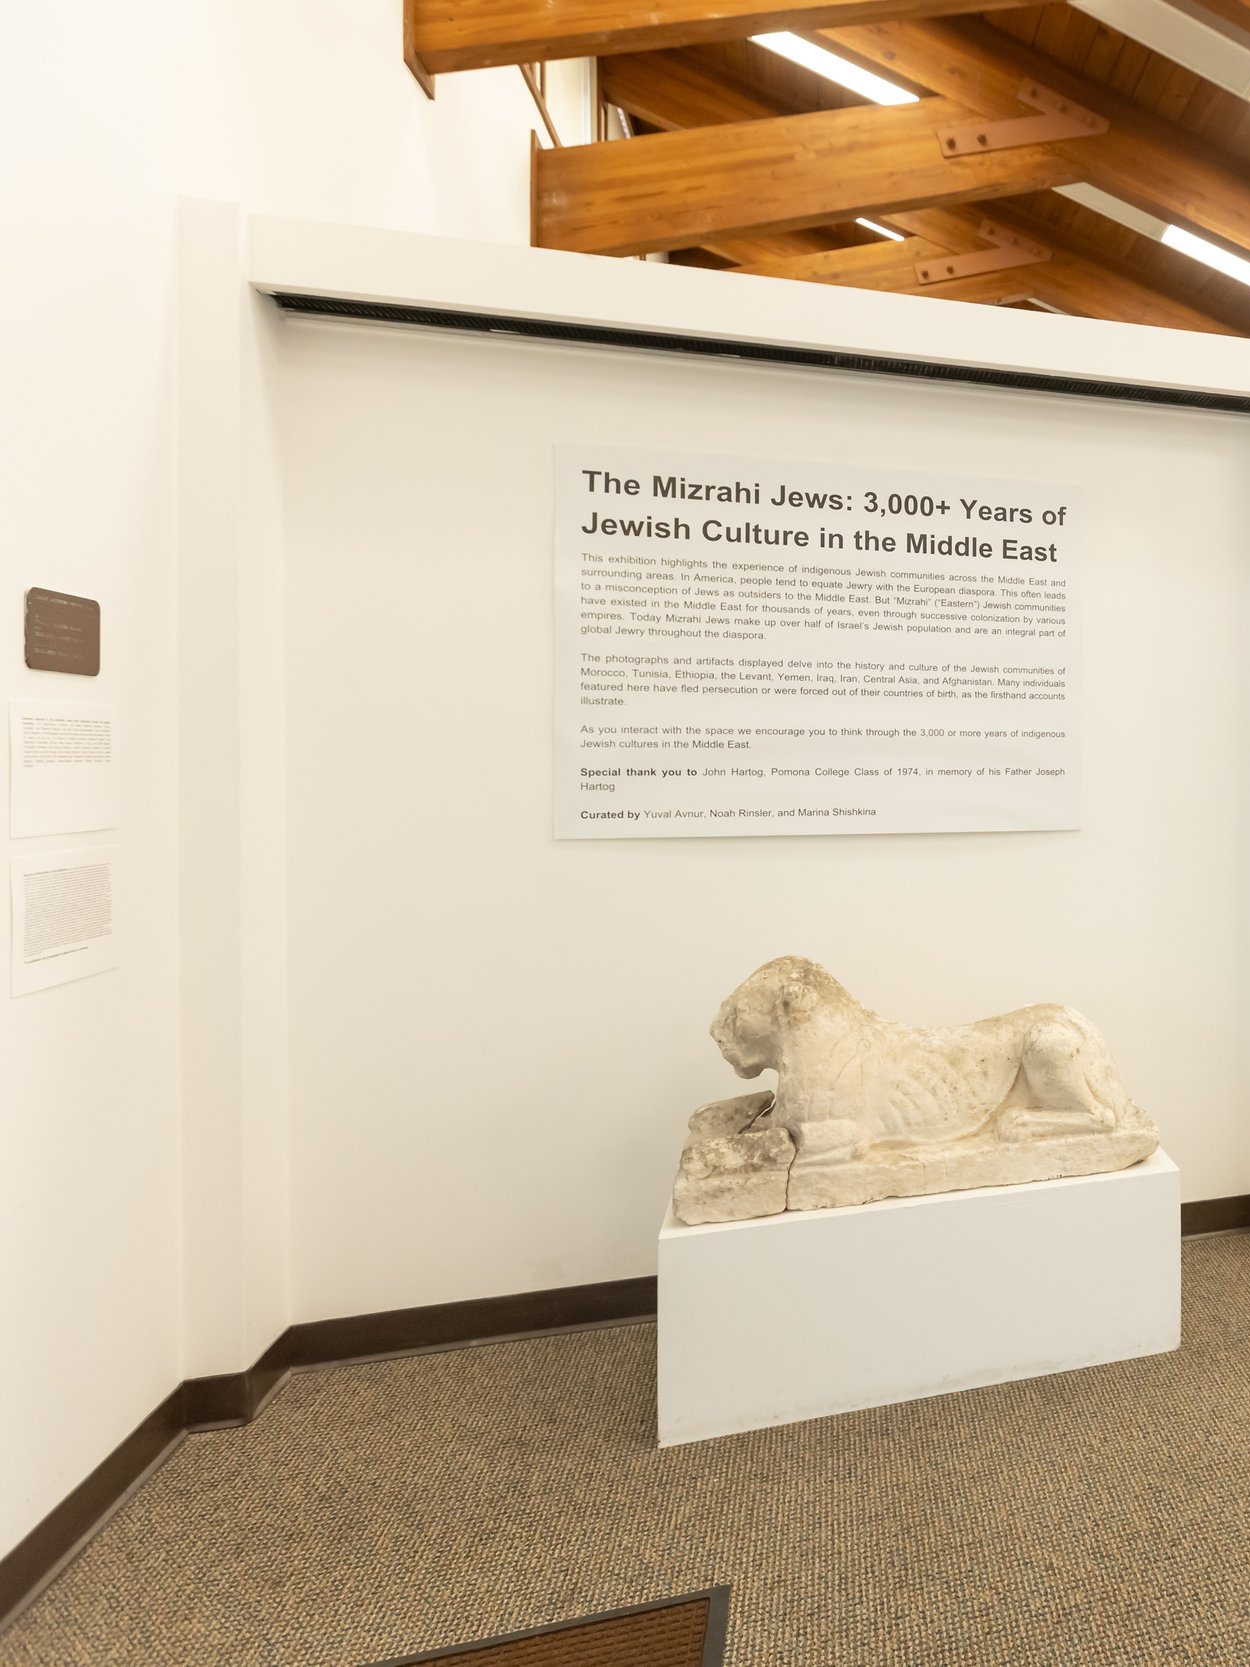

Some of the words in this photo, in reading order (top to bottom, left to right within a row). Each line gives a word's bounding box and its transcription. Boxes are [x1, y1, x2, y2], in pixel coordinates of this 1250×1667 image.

[581, 469, 640, 495] The
[652, 475, 760, 504] Mizrahi
[770, 484, 852, 512] Jews:
[863, 491, 950, 520] 3,000+
[959, 498, 1033, 528] Years
[1041, 506, 1067, 526] of
[581, 511, 690, 540] Jewish
[701, 519, 809, 548] Culture
[819, 526, 844, 550] in
[853, 529, 896, 552] the
[906, 529, 993, 559] Middle
[1002, 536, 1057, 563] East
[581, 552, 603, 562] This
[607, 555, 656, 565] exhibition
[660, 557, 707, 570] highlights
[712, 560, 727, 569] the
[731, 562, 784, 573] experience
[788, 564, 797, 572] of
[801, 565, 851, 577] indigenous
[855, 567, 886, 577] Jewish
[889, 571, 945, 581] communities
[948, 574, 977, 582] across
[980, 574, 994, 583] the
[997, 575, 1025, 585] Middle
[1028, 577, 1047, 586] East
[1050, 579, 1065, 587] and
[581, 569, 641, 581] surrounding
[645, 572, 676, 580] areas.
[680, 572, 690, 581] In
[693, 572, 736, 584] America,
[740, 576, 772, 587] people
[775, 577, 796, 586] tend
[799, 579, 808, 587] to
[811, 580, 843, 590] equate
[845, 580, 872, 593] Jewry
[875, 582, 893, 591] with
[896, 583, 910, 592] the
[913, 584, 955, 595] European
[958, 586, 997, 597] diaspora.
[1000, 588, 1018, 597] This
[1020, 589, 1041, 598] often
[1043, 591, 1065, 599] leads
[580, 624, 612, 635] global
[614, 625, 645, 638] Jewry
[647, 627, 701, 639] throughout
[704, 628, 720, 639] the
[722, 629, 766, 641] diaspora.
[580, 652, 600, 662] The
[605, 654, 669, 666] photographs
[673, 656, 691, 665] and
[695, 656, 734, 666] artifacts
[738, 657, 783, 669] displayed
[787, 659, 812, 668] delve
[816, 660, 833, 668] into
[836, 660, 851, 669] the
[854, 661, 884, 672] history
[888, 662, 905, 670] and
[908, 663, 938, 671] culture
[941, 663, 950, 672] of
[953, 664, 967, 672] the
[970, 664, 999, 673] Jewish
[1002, 665, 1054, 674] communities
[1057, 666, 1065, 675] of
[580, 667, 628, 678] Morocco,
[631, 668, 671, 679] Tunisia,
[674, 669, 717, 681] Ethiopia,
[720, 671, 736, 680] the
[739, 671, 774, 682] Levant,
[776, 671, 813, 682] Yemen,
[816, 673, 836, 684] Iraq,
[839, 673, 860, 684] Iran,
[862, 674, 895, 683] Central
[897, 675, 920, 685] Asia,
[922, 676, 939, 685] and
[941, 676, 994, 687] Afghanistan.
[997, 677, 1020, 689] Many
[1022, 678, 1065, 689] individuals
[580, 681, 623, 691] featured
[626, 683, 649, 691] here
[653, 683, 677, 692] have
[680, 683, 698, 692] fled
[702, 685, 758, 695] persecution
[773, 687, 797, 695] were
[799, 686, 828, 695] forced
[831, 688, 846, 696] out
[848, 687, 858, 696] of
[860, 687, 880, 696] their
[882, 688, 923, 697] countries
[925, 689, 935, 697] of
[937, 689, 958, 698] birth,
[974, 690, 988, 698] the
[990, 690, 1026, 699] firsthand
[1028, 692, 1065, 700] accounts
[580, 697, 627, 706] illustrate.
[580, 724, 594, 733] As
[597, 726, 616, 736] you
[620, 725, 658, 734] interact
[661, 725, 682, 734] with
[685, 726, 701, 734] the
[704, 727, 734, 738] space
[754, 728, 805, 738] encourage
[808, 728, 825, 738] you
[828, 727, 837, 735] to
[840, 727, 862, 736] think
[865, 727, 899, 739] through
[902, 728, 916, 736] the
[919, 728, 944, 736] 3,000
[984, 730, 1007, 740] years
[1009, 729, 1018, 737] of
[1021, 729, 1065, 740] indigenous
[579, 739, 615, 748] Jewish
[618, 739, 658, 748] cultures
[661, 739, 670, 748] in
[673, 739, 689, 748] the
[692, 739, 724, 751] Middle
[727, 739, 751, 751] East.
[580, 767, 620, 779] Special
[625, 767, 656, 776] thank
[661, 769, 681, 779] you
[686, 768, 697, 776] to
[701, 767, 726, 776] John
[731, 767, 765, 778] Hartog,
[771, 767, 809, 776] Pomona
[814, 767, 849, 778] College
[853, 767, 879, 775] Class
[883, 767, 892, 775] of
[897, 767, 920, 776] 1974,
[925, 767, 933, 775] in
[937, 769, 972, 778] memory
[976, 767, 984, 775] of
[988, 767, 1000, 775] his
[1004, 767, 1032, 775] Father
[1035, 767, 1065, 777] Joseph
[580, 782, 616, 793] Hartog
[580, 808, 624, 821] Curated
[627, 809, 640, 821] by
[643, 808, 671, 818] Yuval
[674, 809, 706, 820] Avnur,
[709, 808, 735, 819] Noah
[738, 808, 774, 818] Rinsler,
[777, 808, 795, 817] and
[797, 807, 829, 816] Marina
[832, 807, 876, 816] Shishkina
